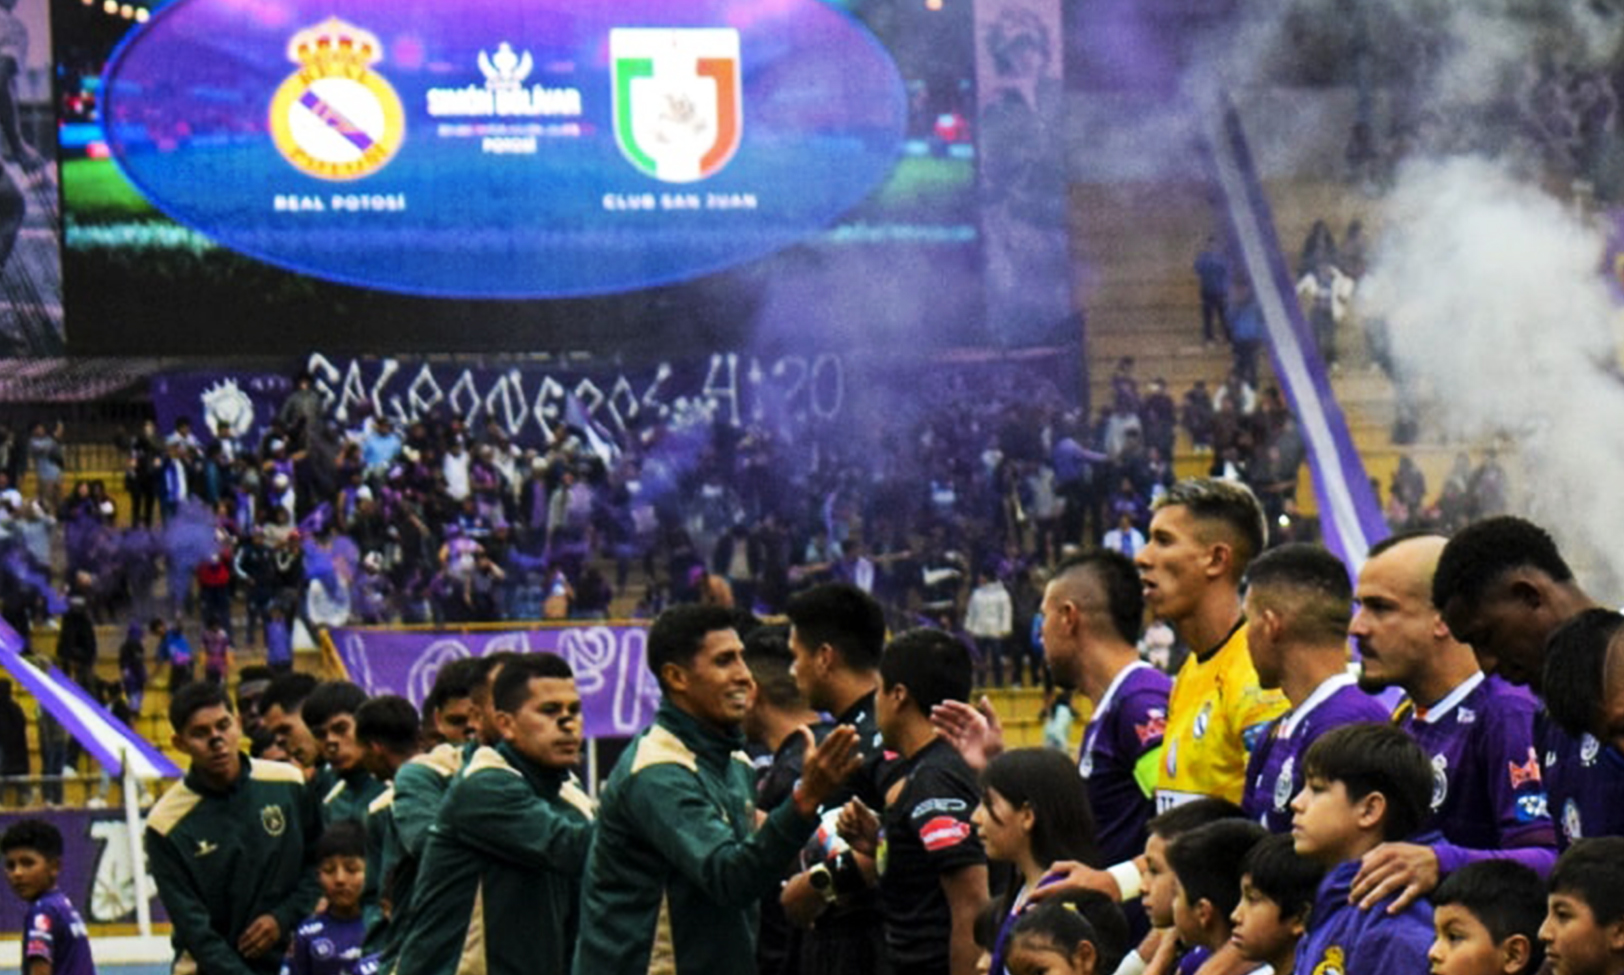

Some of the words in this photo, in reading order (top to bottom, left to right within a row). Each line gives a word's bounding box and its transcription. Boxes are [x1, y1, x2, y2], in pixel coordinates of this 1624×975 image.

[273, 193, 325, 211] REAL
[331, 190, 407, 211] POTOSÍ
[602, 193, 656, 211] CLUB
[660, 193, 701, 211] SAN
[706, 193, 758, 211] JUAN
